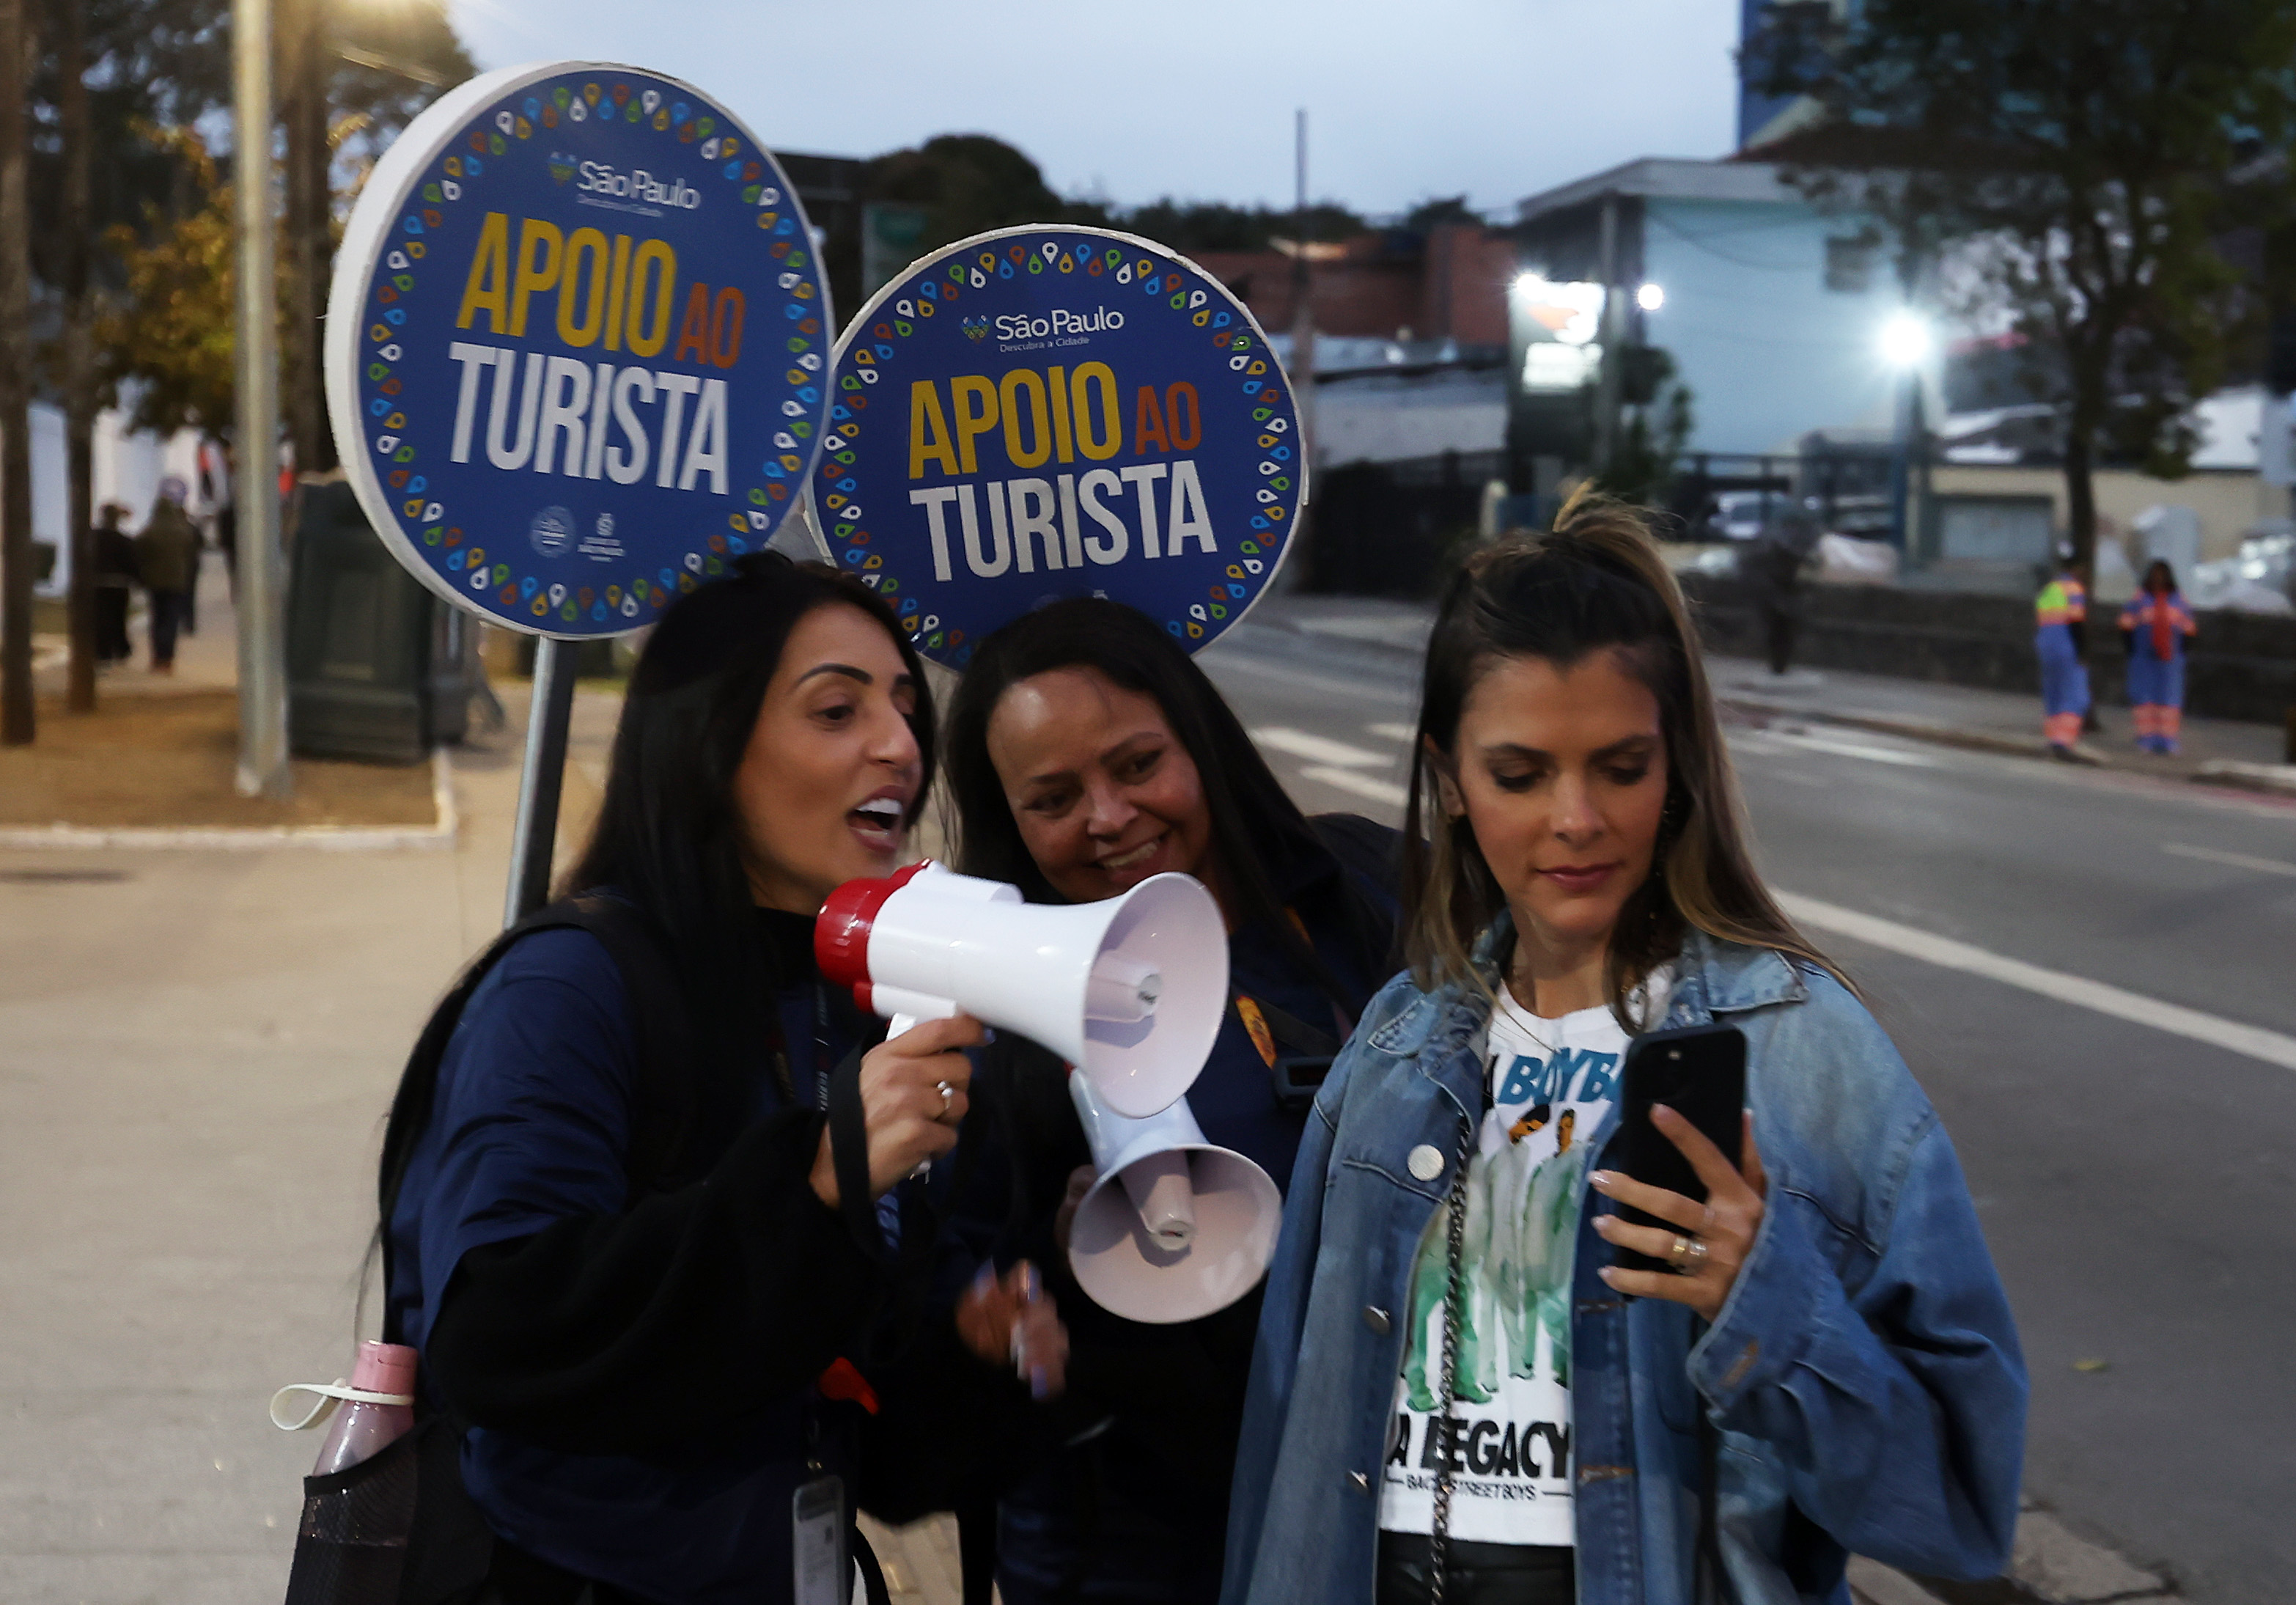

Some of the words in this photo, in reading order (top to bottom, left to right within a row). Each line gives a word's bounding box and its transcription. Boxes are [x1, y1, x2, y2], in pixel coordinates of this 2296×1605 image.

[576, 161, 630, 196] São
[630, 169, 701, 209] Paulo
[456, 212, 677, 358] APOIO
[674, 282, 746, 369] AO
[995, 314, 1050, 340] São
[1051, 305, 1125, 335] Paulo
[1055, 337, 1090, 347] Cidade
[449, 341, 729, 495] TURISTA
[908, 361, 1122, 480] APOIO
[1135, 381, 1202, 455] AO
[908, 459, 1218, 582] TURISTA
[1498, 1047, 1621, 1105] BOYB
[1386, 1414, 1410, 1466] A
[1420, 1415, 1570, 1479] LEGACY
